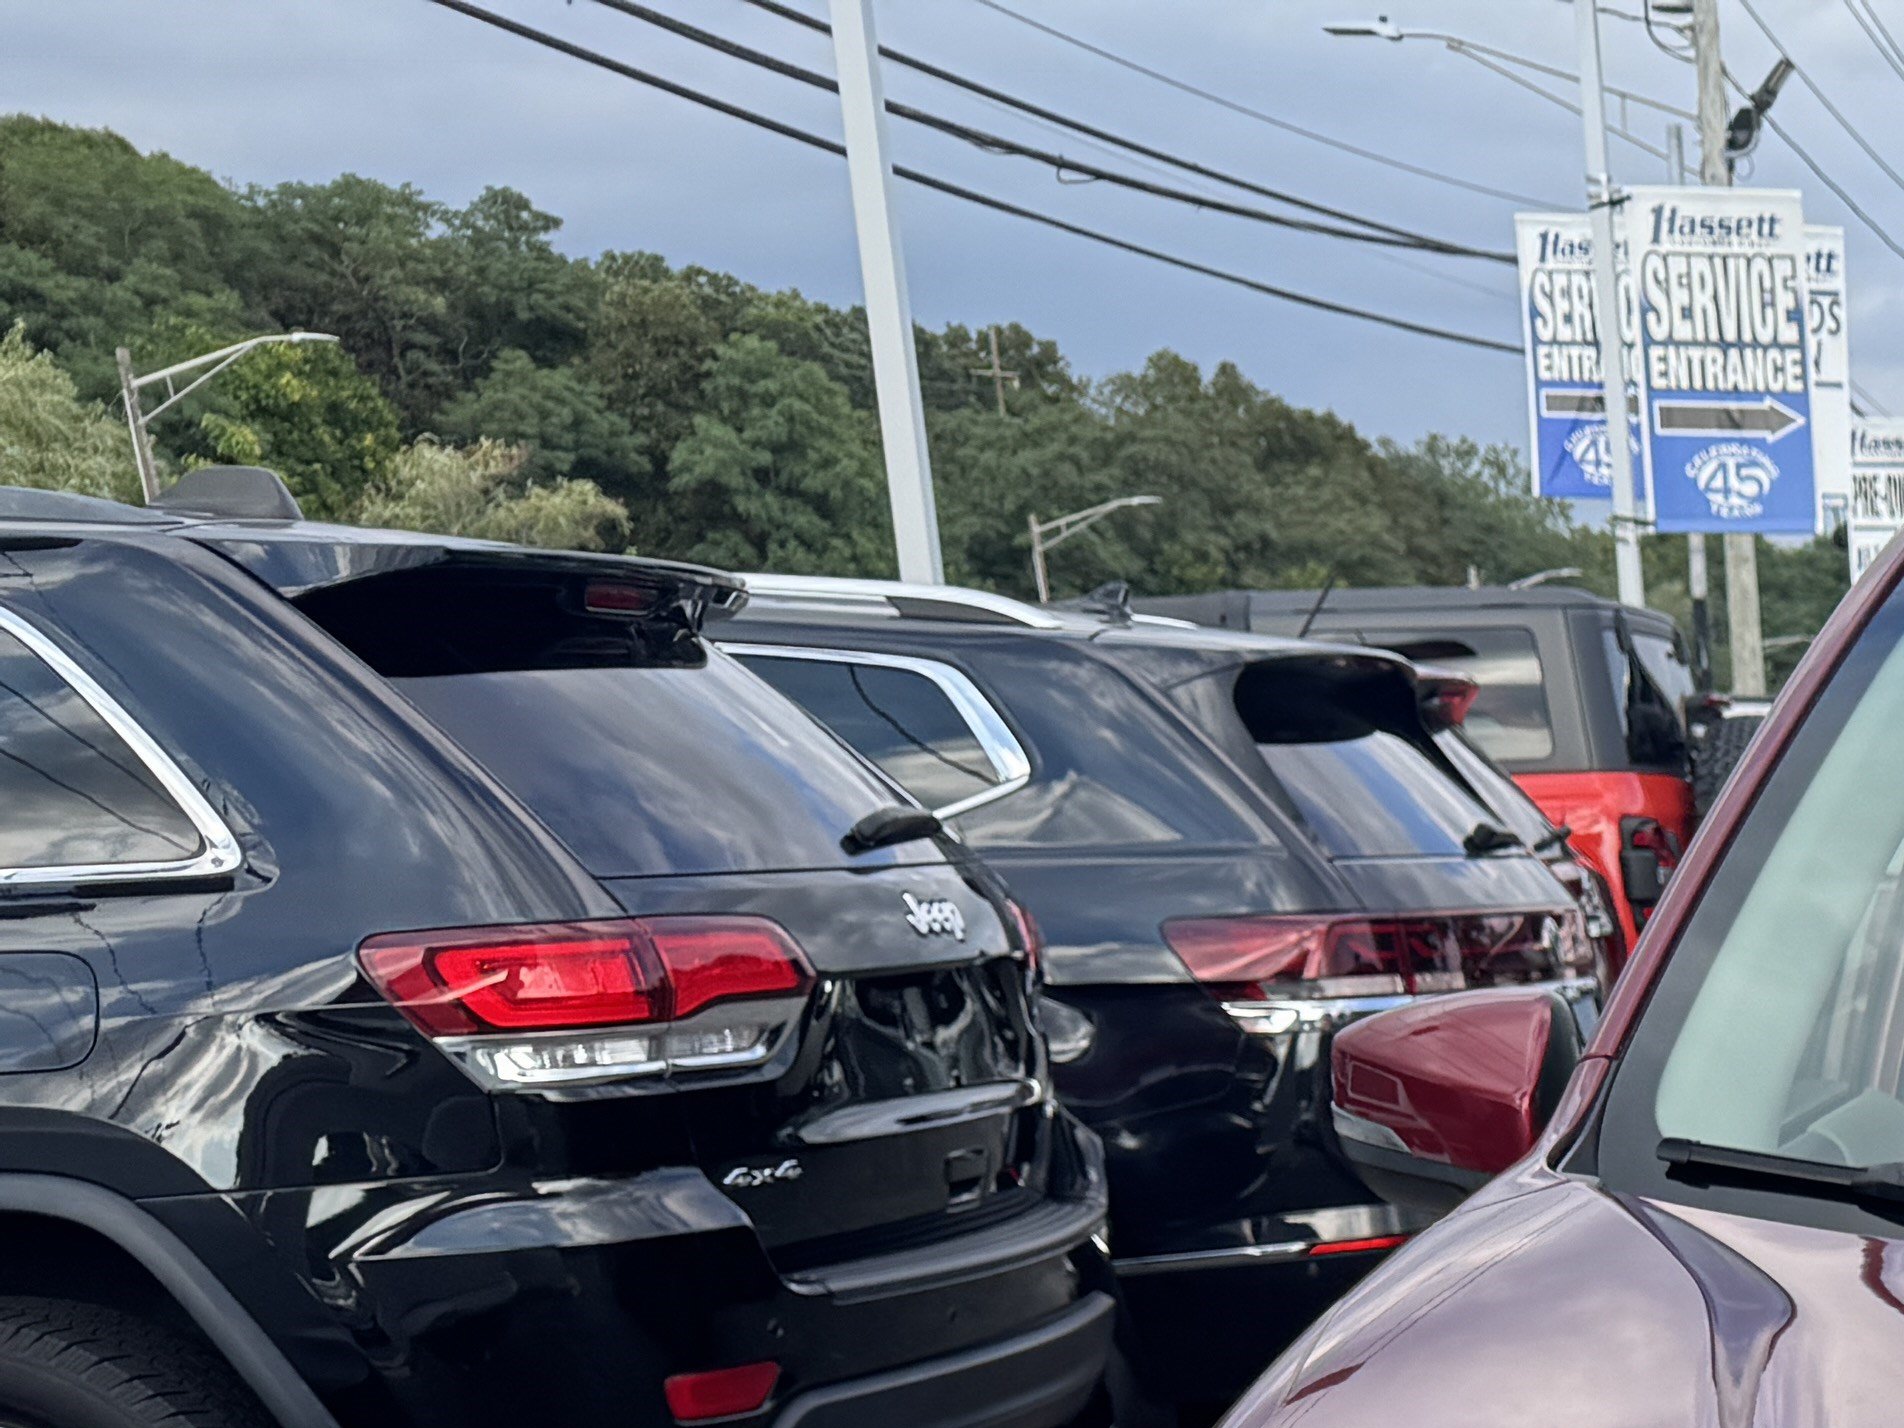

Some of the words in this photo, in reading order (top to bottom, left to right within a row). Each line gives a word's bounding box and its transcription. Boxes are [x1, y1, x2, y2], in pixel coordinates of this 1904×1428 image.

[1650, 202, 1781, 244] Hassett
[1642, 250, 1801, 346] SERVICE
[1649, 344, 1804, 392] ENTRANCE
[1702, 461, 1765, 500] 45
[902, 892, 965, 940] Jeep
[722, 1158, 804, 1188] 4x4
